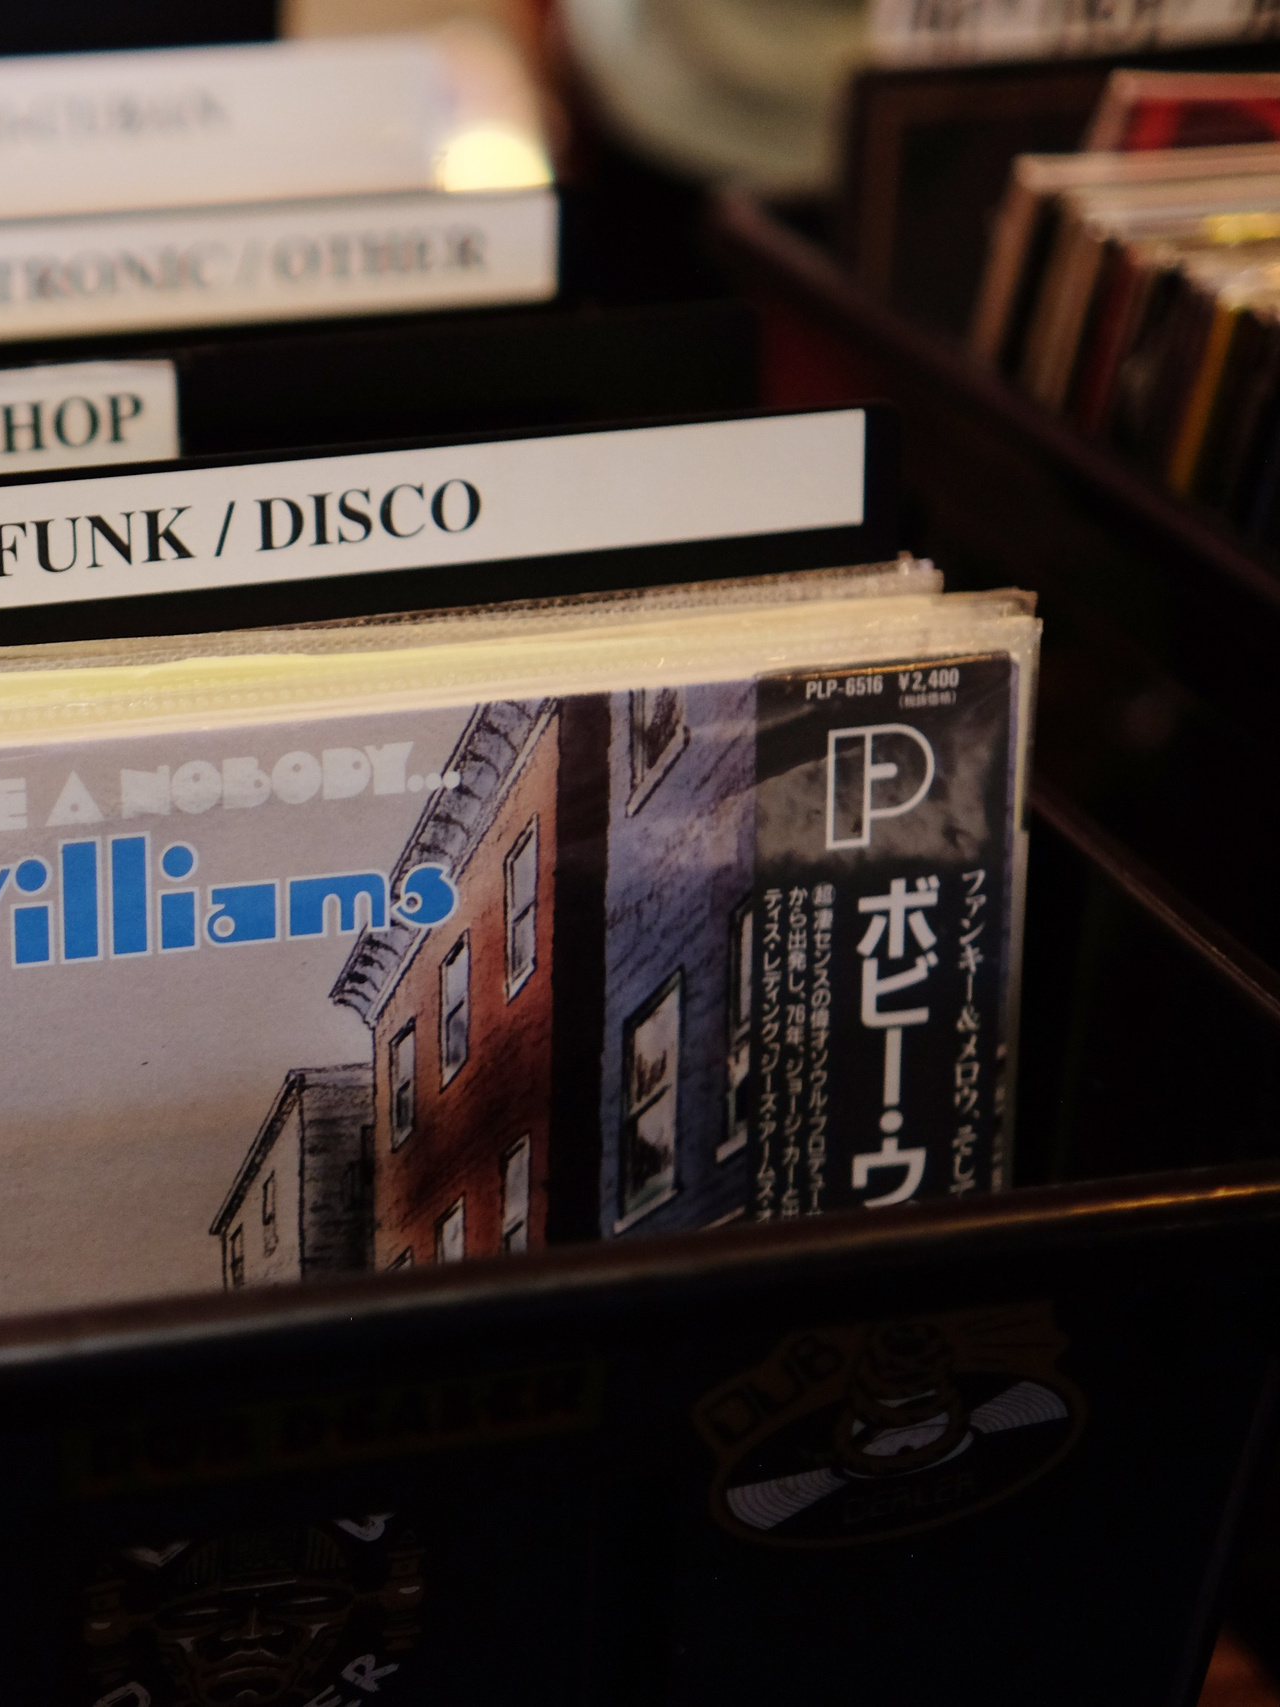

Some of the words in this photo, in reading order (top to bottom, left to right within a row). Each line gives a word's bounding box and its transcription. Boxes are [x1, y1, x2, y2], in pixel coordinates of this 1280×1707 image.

[272, 225, 489, 286] OTHER
[1, 391, 145, 454] HOP
[212, 500, 237, 556] /
[257, 478, 482, 552] DISCO
[805, 674, 884, 701] PLP-6516
[45, 770, 107, 827] A
[121, 741, 461, 817] NOBODY...
[705, 1335, 842, 1444] DUB
[840, 1471, 980, 1525] DEALER
